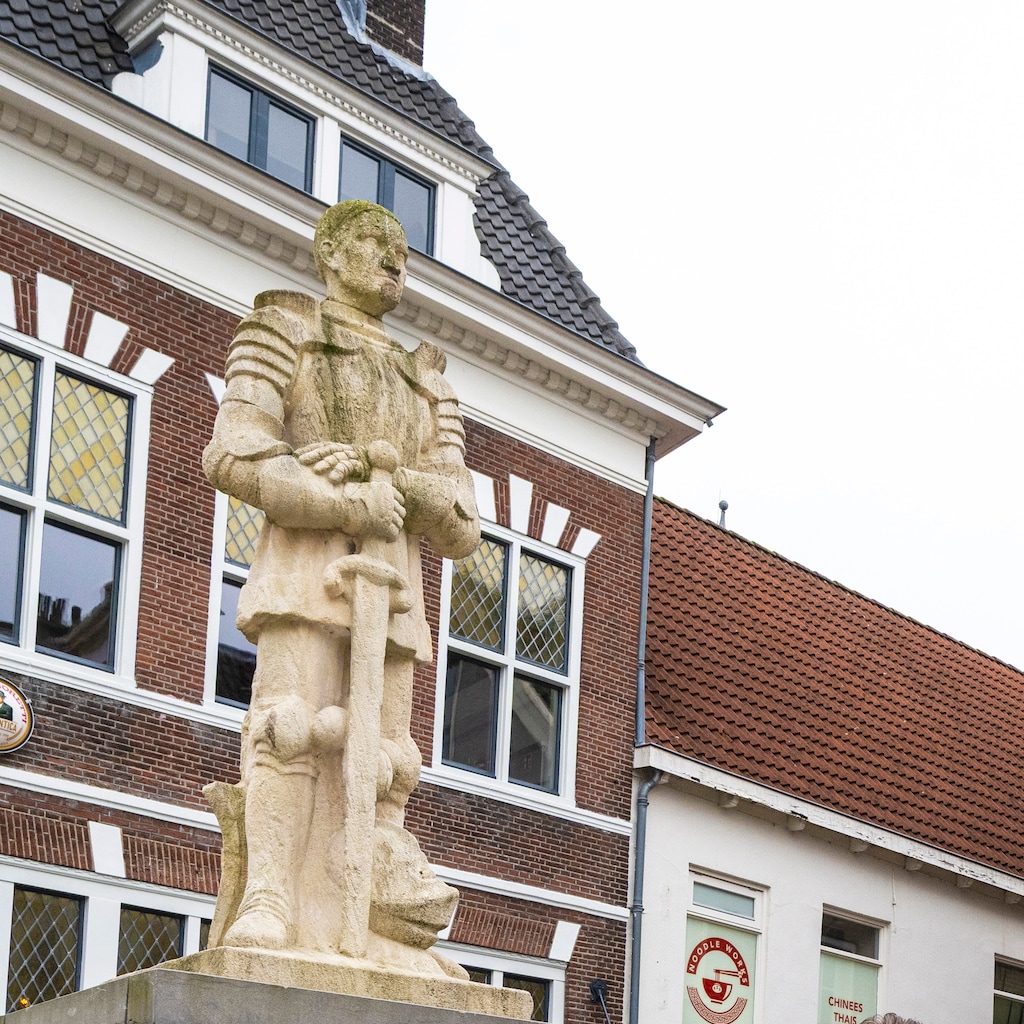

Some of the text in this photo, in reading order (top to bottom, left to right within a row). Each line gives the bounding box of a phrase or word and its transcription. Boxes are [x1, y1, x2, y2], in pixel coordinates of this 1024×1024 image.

[687, 940, 749, 985] NOODLE WORKS
[828, 996, 863, 1013] CHINEES
